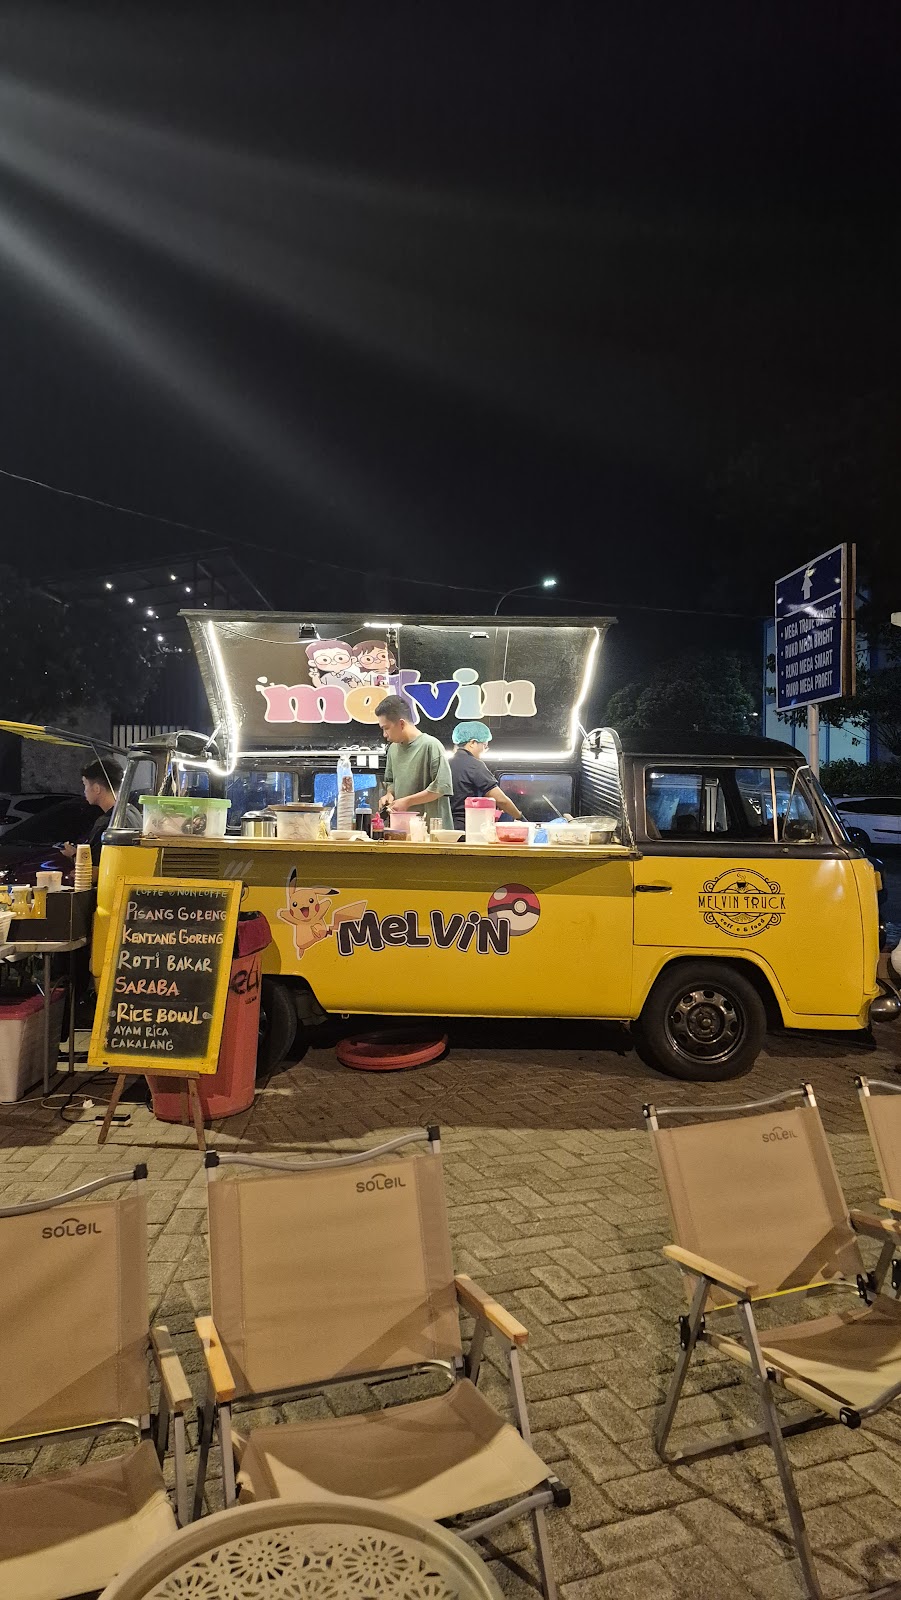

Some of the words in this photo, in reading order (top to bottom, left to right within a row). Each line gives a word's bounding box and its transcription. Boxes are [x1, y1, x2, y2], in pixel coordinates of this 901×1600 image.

[784, 621, 799, 640] MEGA
[785, 641, 798, 659] RUKO
[799, 634, 813, 654] MEGA
[814, 627, 834, 649] BRIGHT
[785, 661, 799, 679] RUKO
[799, 656, 814, 675] MEGA
[814, 649, 833, 670] SMART
[785, 681, 799, 698] RUKO
[800, 676, 814, 694] MEGA
[814, 670, 833, 690] PROFIT
[126, 901, 174, 920] PISANG
[177, 907, 227, 921] GORENG
[698, 896, 739, 910] MELVIN
[744, 896, 786, 910] TRUCK
[750, 918, 765, 930] food
[122, 925, 176, 945] KENTANG
[178, 929, 224, 945] GORENG
[167, 955, 213, 973] BAKAR
[115, 976, 180, 996] SARABA
[156, 1006, 203, 1025] BOWL
[113, 1025, 142, 1037] AYAM
[110, 1038, 174, 1051] CAKALANG
